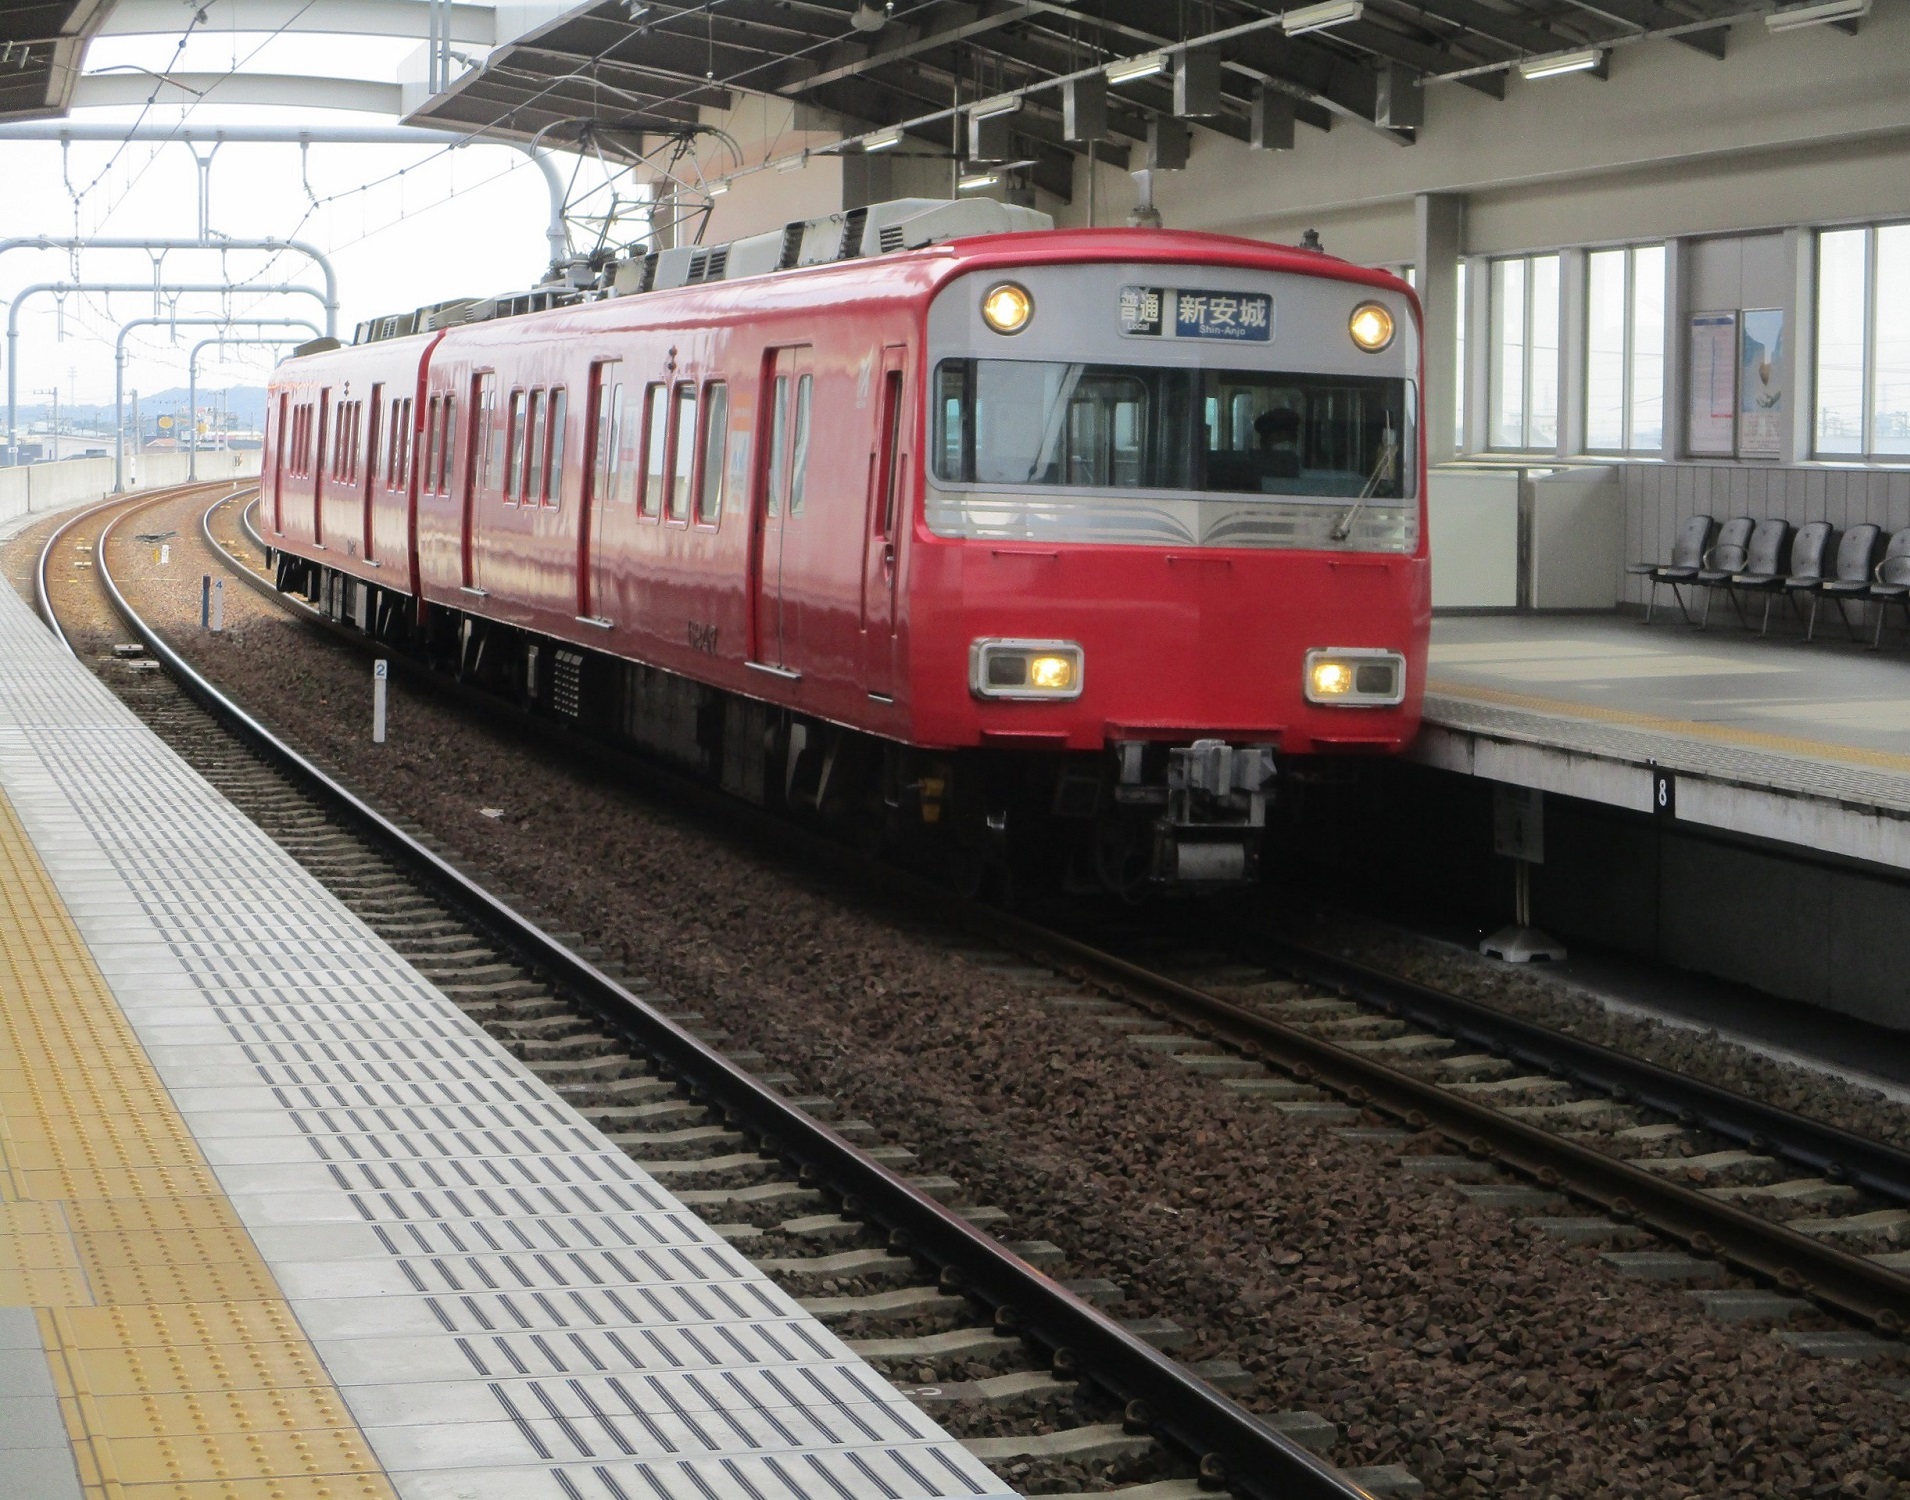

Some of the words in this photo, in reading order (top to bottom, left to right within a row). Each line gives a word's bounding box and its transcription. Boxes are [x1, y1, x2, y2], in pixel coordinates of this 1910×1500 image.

[1120, 291, 1158, 322] 普通
[1179, 295, 1266, 328] 新安城
[1127, 322, 1150, 331] Local
[1200, 325, 1246, 337] Shin-Anjo
[216, 581, 223, 590] 4
[376, 663, 385, 676] 2
[1658, 778, 1667, 806] 8
